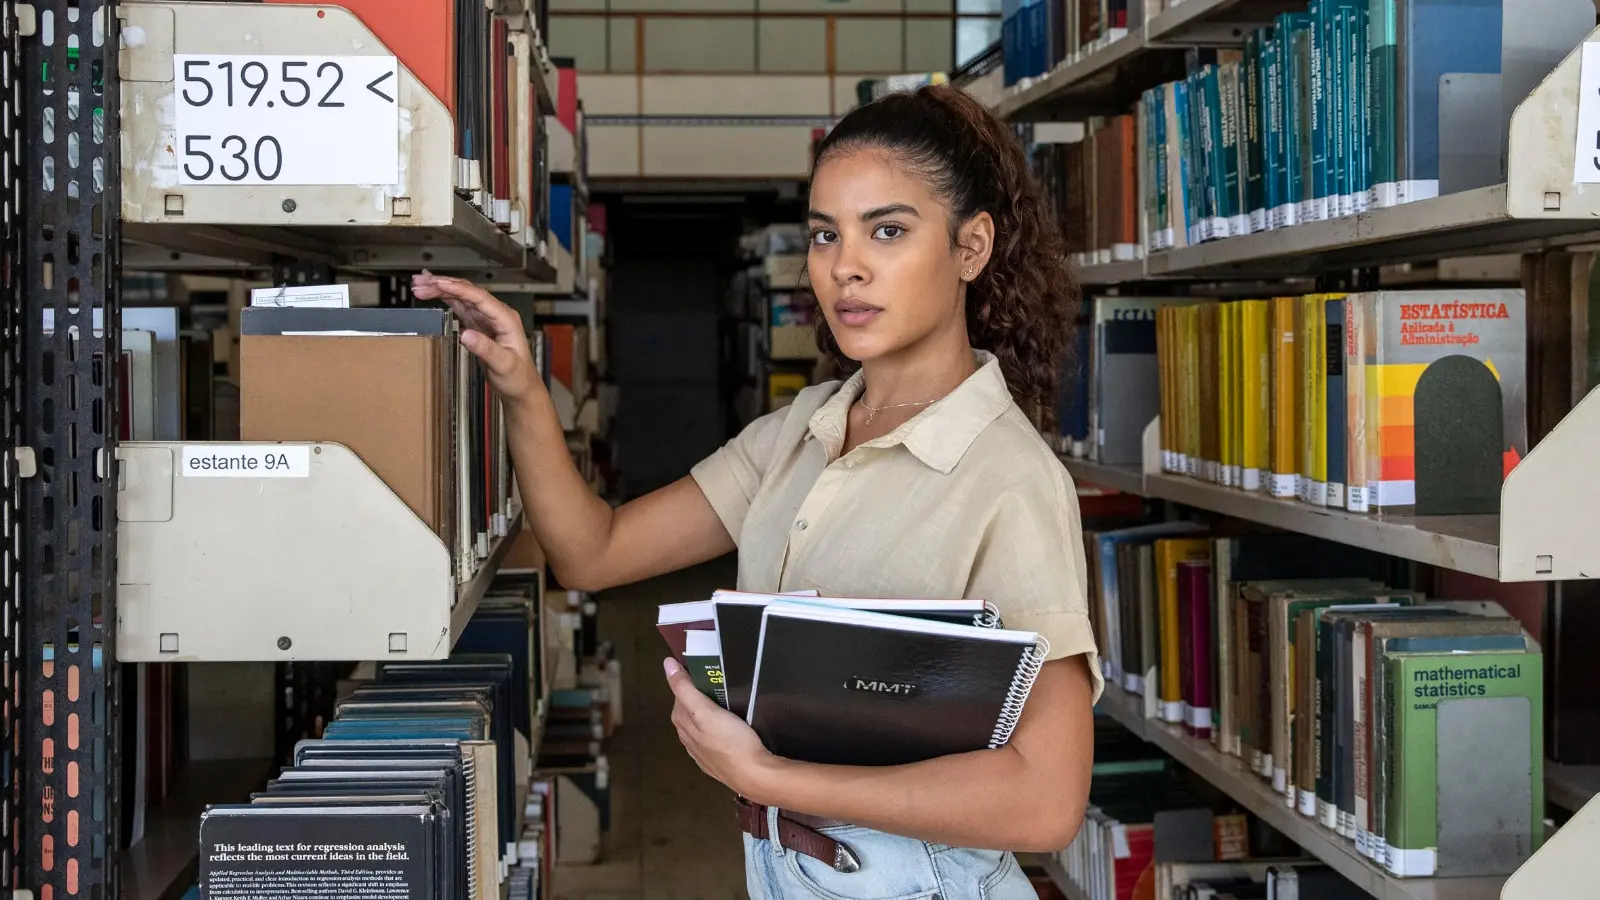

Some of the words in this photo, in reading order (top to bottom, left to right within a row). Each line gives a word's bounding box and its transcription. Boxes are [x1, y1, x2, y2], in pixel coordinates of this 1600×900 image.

[182, 60, 345, 107] 519.52
[183, 134, 283, 181] 530
[1400, 300, 1509, 319] ESTATÍSTICA
[1401, 322, 1445, 333] Aplicada
[1401, 333, 1480, 347] Administração
[190, 454, 258, 470] estante
[264, 453, 290, 470] 9A
[1414, 664, 1521, 681] mathematical
[1414, 682, 1486, 697] statistics
[1414, 703, 1436, 711] SAMUE
[214, 843, 235, 852] This
[238, 843, 274, 853] leading
[297, 843, 312, 851] for
[313, 843, 365, 853] regression
[366, 843, 405, 852] analysis
[209, 853, 245, 861] reflects
[329, 852, 354, 860] ideas
[368, 852, 384, 860] the
[386, 852, 410, 860] field.
